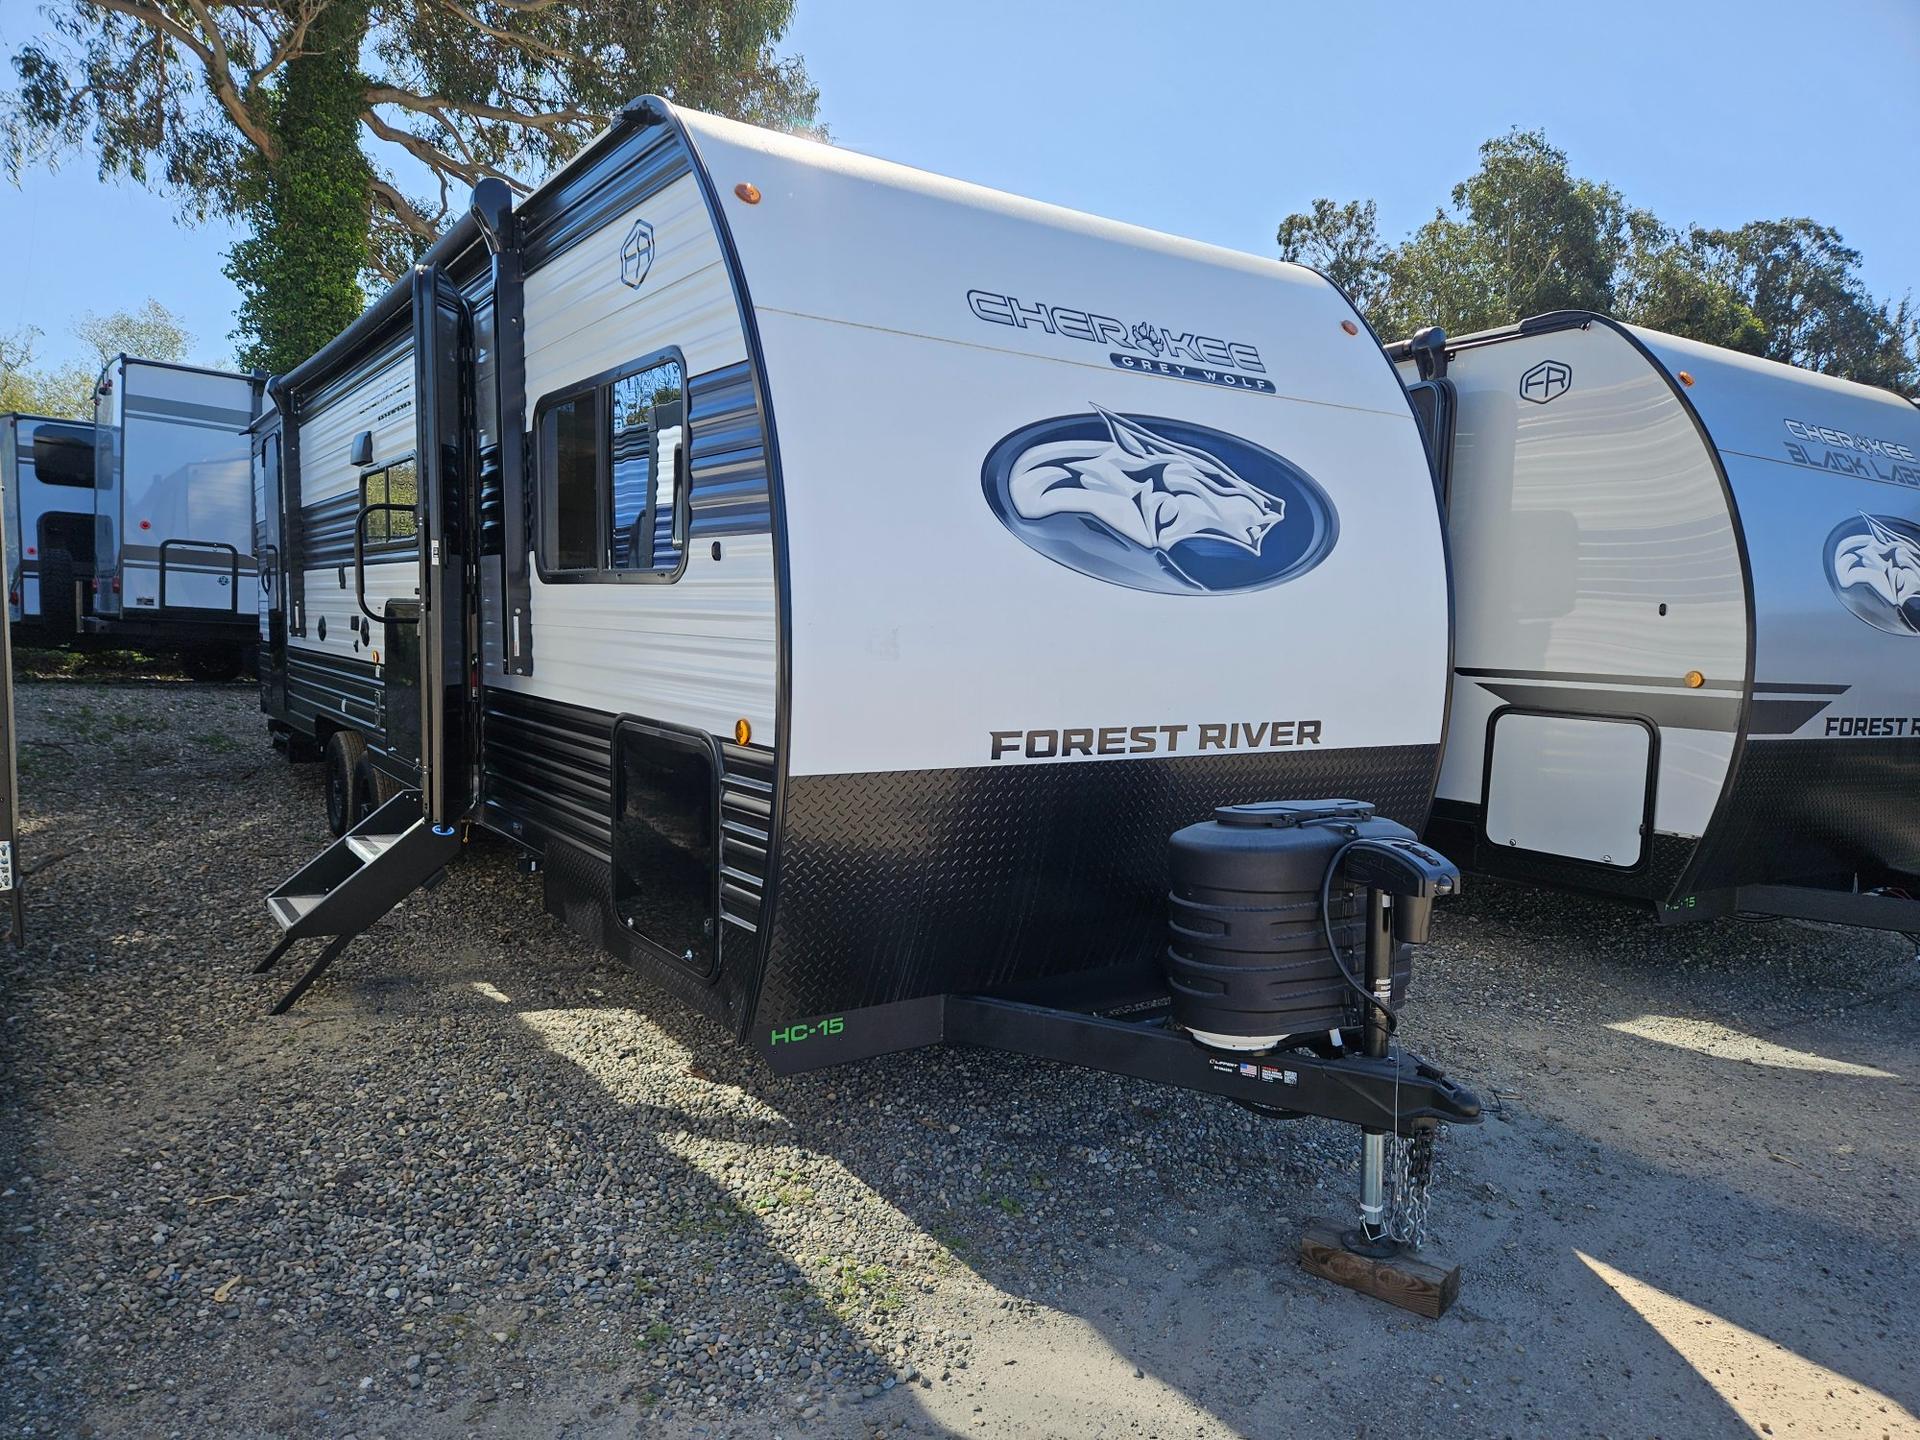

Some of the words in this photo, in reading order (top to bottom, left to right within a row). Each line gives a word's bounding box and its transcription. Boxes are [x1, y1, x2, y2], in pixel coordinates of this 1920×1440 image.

[1122, 356, 1187, 376] GREY
[1203, 370, 1266, 390] WOLF
[1783, 441, 1870, 477] BLACK
[989, 724, 1188, 760] FOREST
[1198, 720, 1322, 750] RIVER
[1825, 717, 1908, 736] FOREST
[771, 1017, 844, 1046] HC-15
